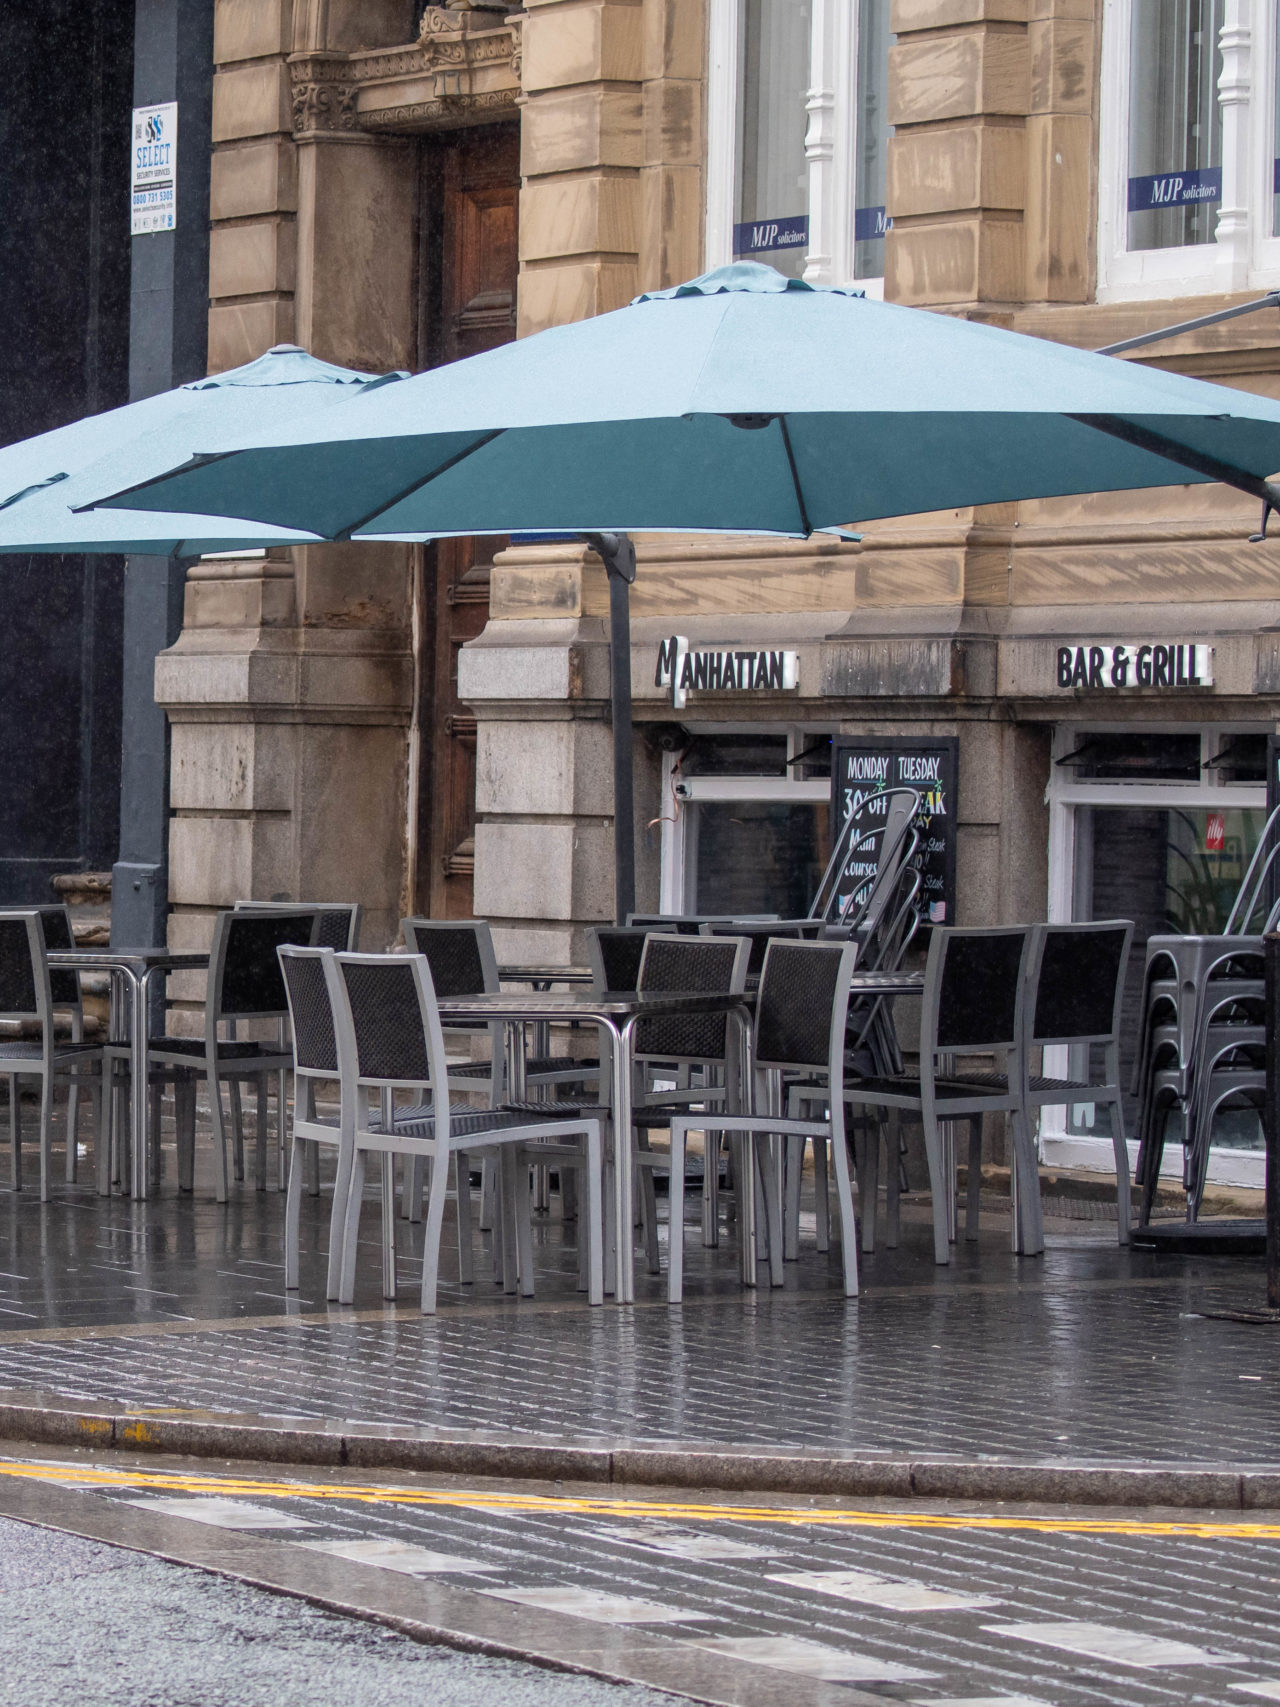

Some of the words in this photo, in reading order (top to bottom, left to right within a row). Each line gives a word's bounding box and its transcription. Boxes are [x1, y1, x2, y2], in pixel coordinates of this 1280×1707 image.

[136, 143, 170, 168] SELECT
[1150, 178, 1183, 203] MJP
[1182, 184, 1217, 199] solicitors
[751, 224, 778, 248] MJP
[777, 230, 807, 245] solicitors
[655, 635, 784, 709] MANHATTAN
[1058, 646, 1105, 688] BAR
[1111, 645, 1130, 688] &
[1136, 645, 1201, 687] GRILL
[847, 756, 889, 779] MONDAY
[898, 756, 940, 780] TUESDAY
[918, 790, 947, 815] EAK
[1207, 818, 1224, 846] illy
